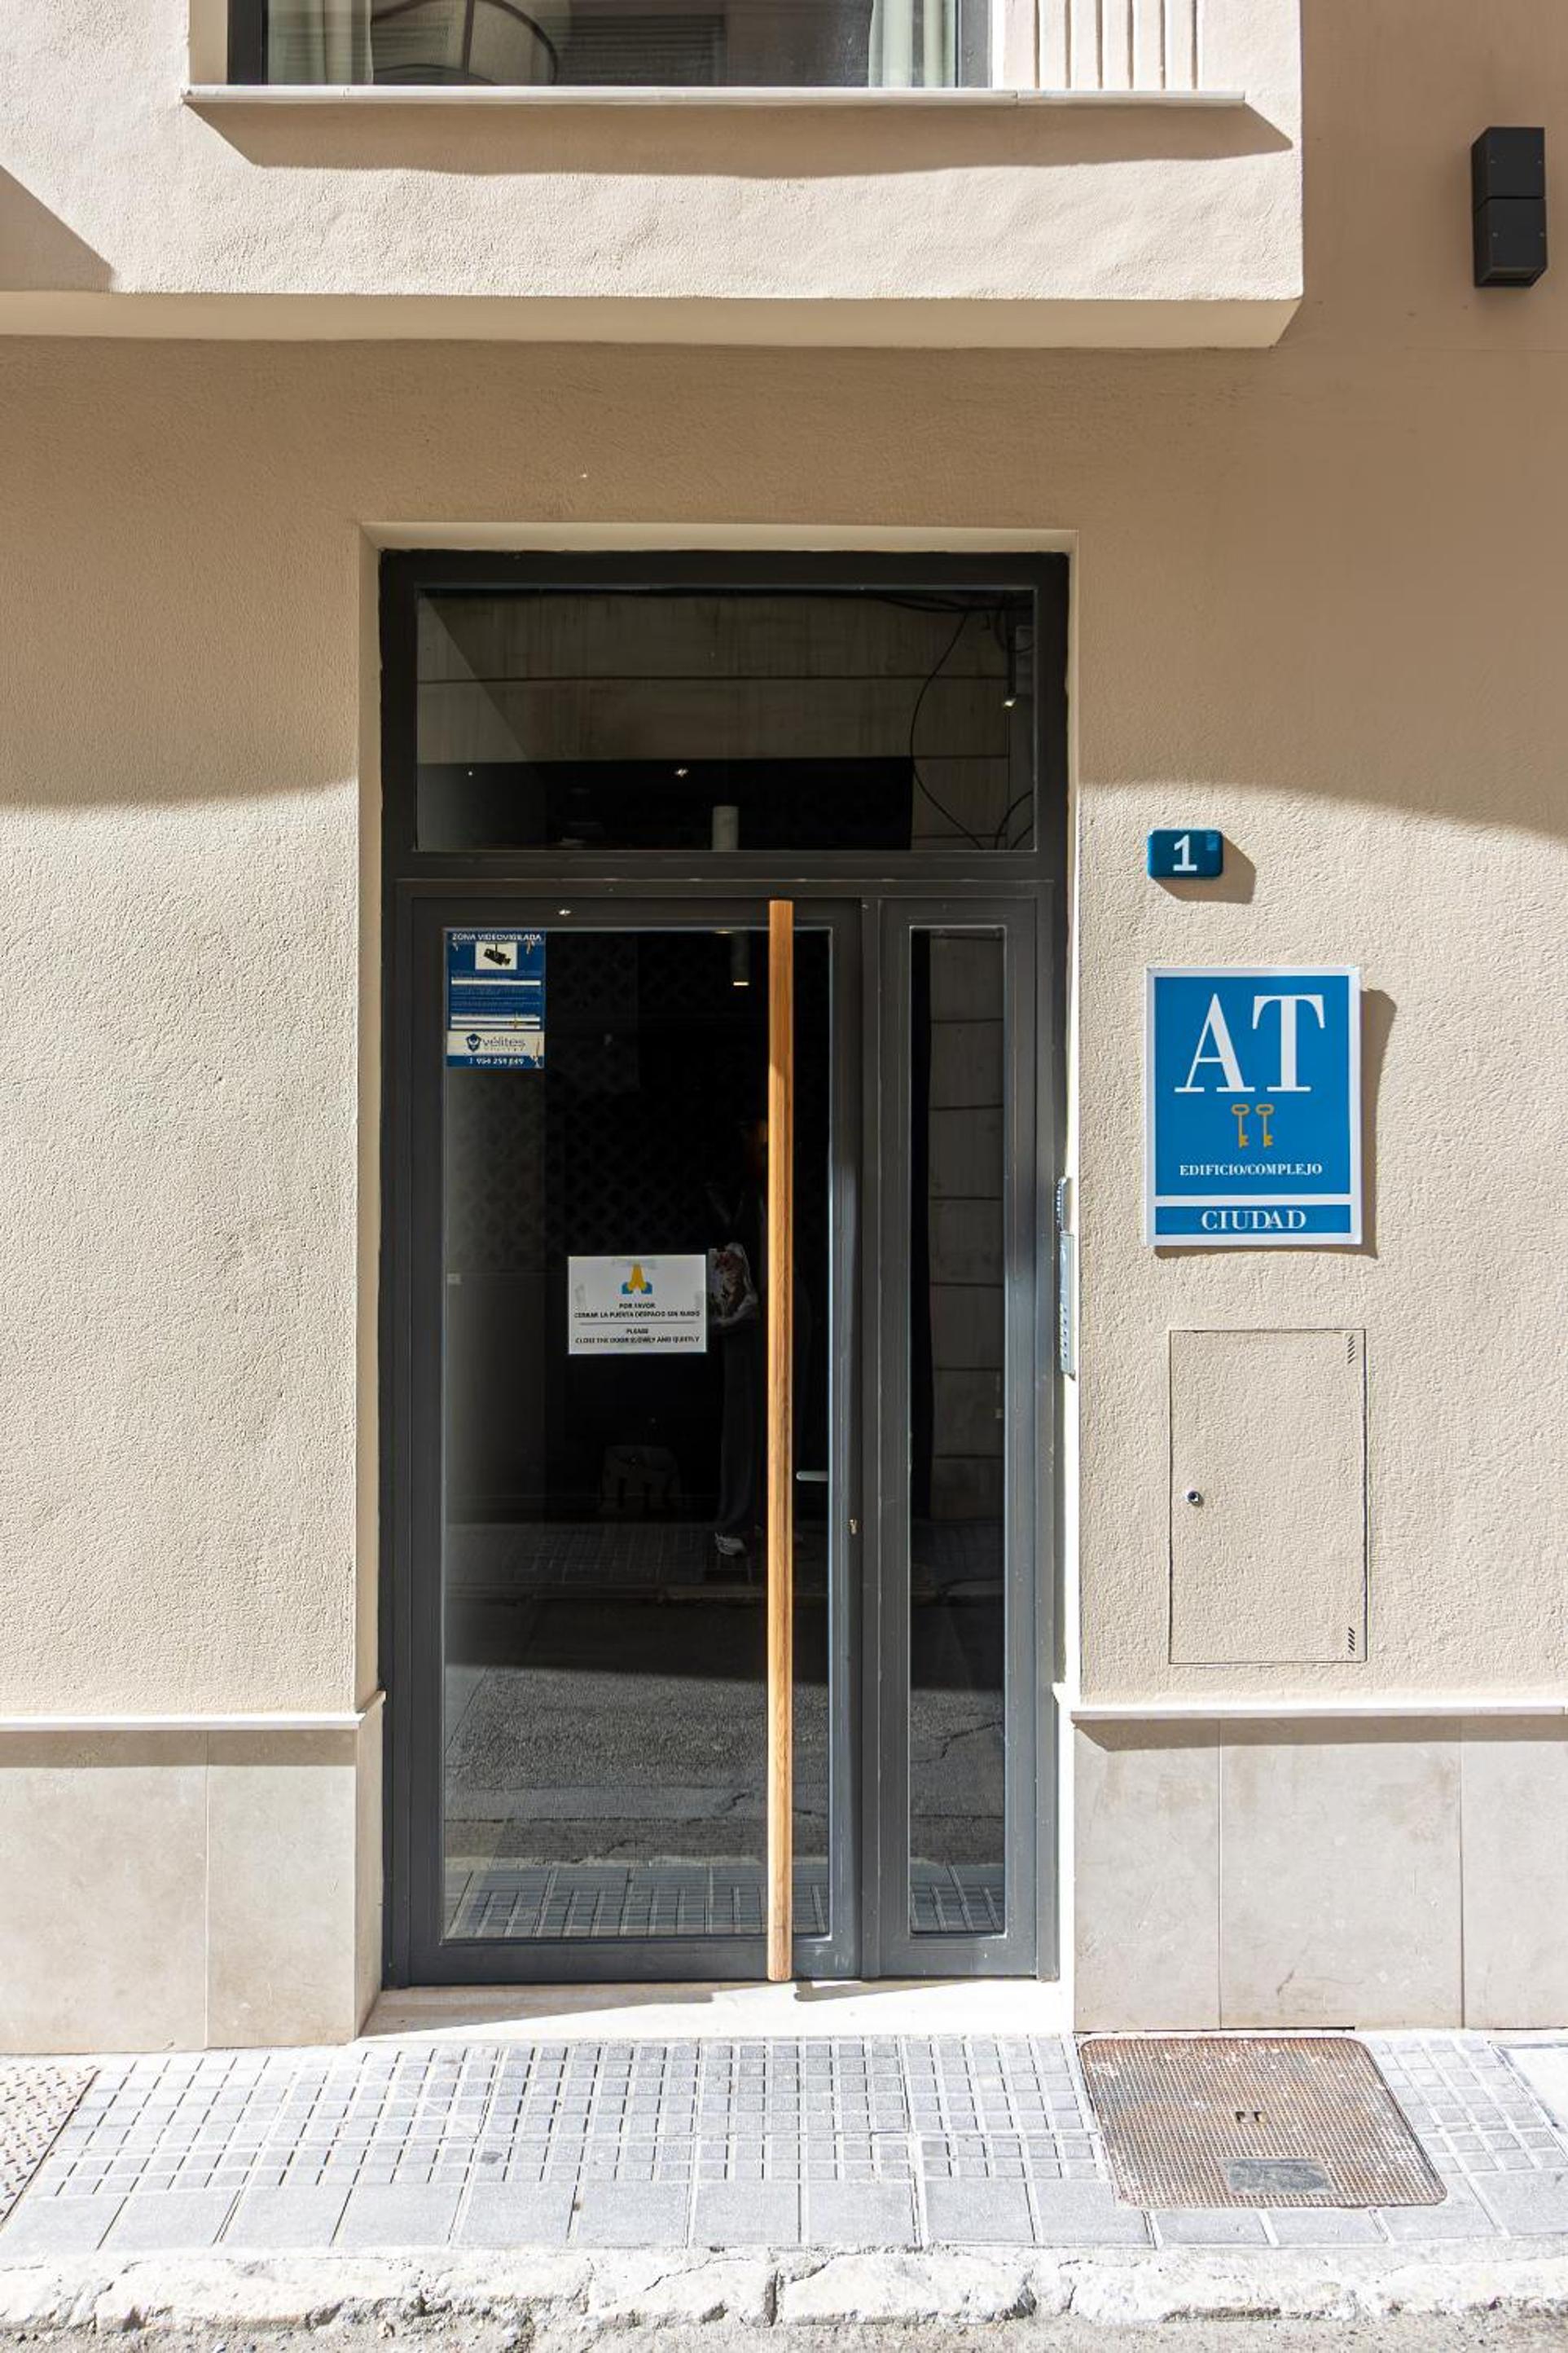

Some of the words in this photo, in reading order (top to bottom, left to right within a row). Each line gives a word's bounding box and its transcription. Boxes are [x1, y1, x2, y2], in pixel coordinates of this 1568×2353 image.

[1173, 833, 1197, 871] 1
[477, 933, 542, 941] VIDEOVIGILADA
[1175, 993, 1325, 1093] AT
[1179, 1163, 1323, 1176] EDIFICIO/COMPLEJO
[1201, 1210, 1307, 1230] CIUDAD
